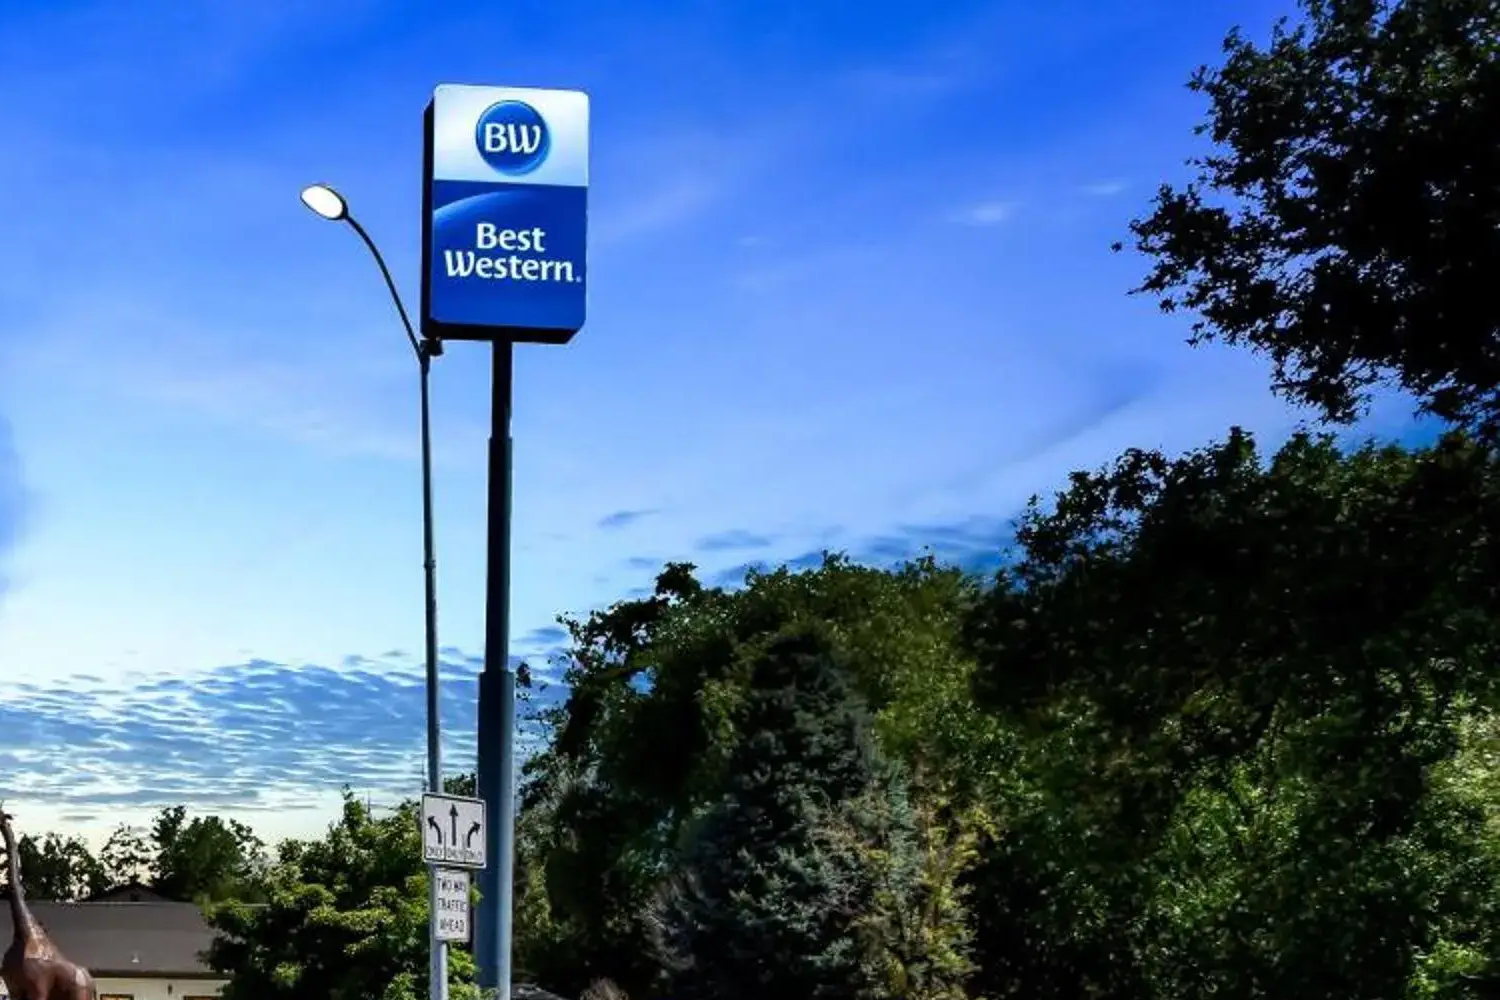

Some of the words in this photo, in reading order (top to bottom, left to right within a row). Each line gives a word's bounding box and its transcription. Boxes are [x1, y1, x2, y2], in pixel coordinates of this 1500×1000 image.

[485, 123, 541, 153] BW
[477, 223, 546, 251] Best
[437, 898, 467, 912] TRAFFIC
[439, 919, 465, 933] AHEAD
